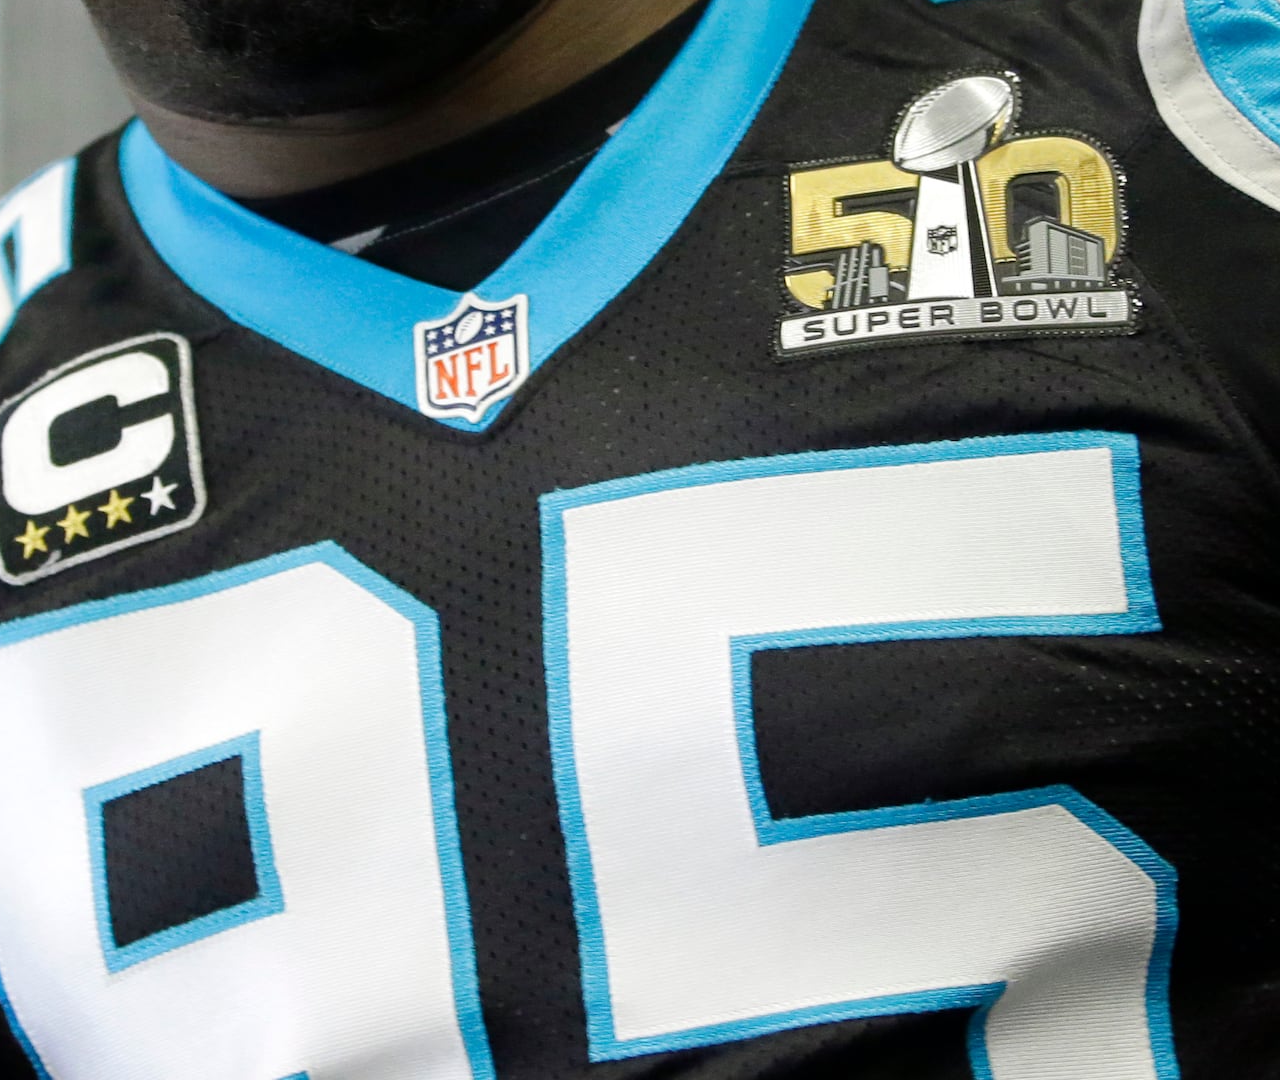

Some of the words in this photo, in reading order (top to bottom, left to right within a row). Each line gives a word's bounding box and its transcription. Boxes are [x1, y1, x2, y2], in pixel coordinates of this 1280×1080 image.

[803, 304, 955, 342] SUPER
[980, 297, 1107, 323] BOWL
[433, 341, 510, 400] NFL
[2, 351, 175, 515] C
